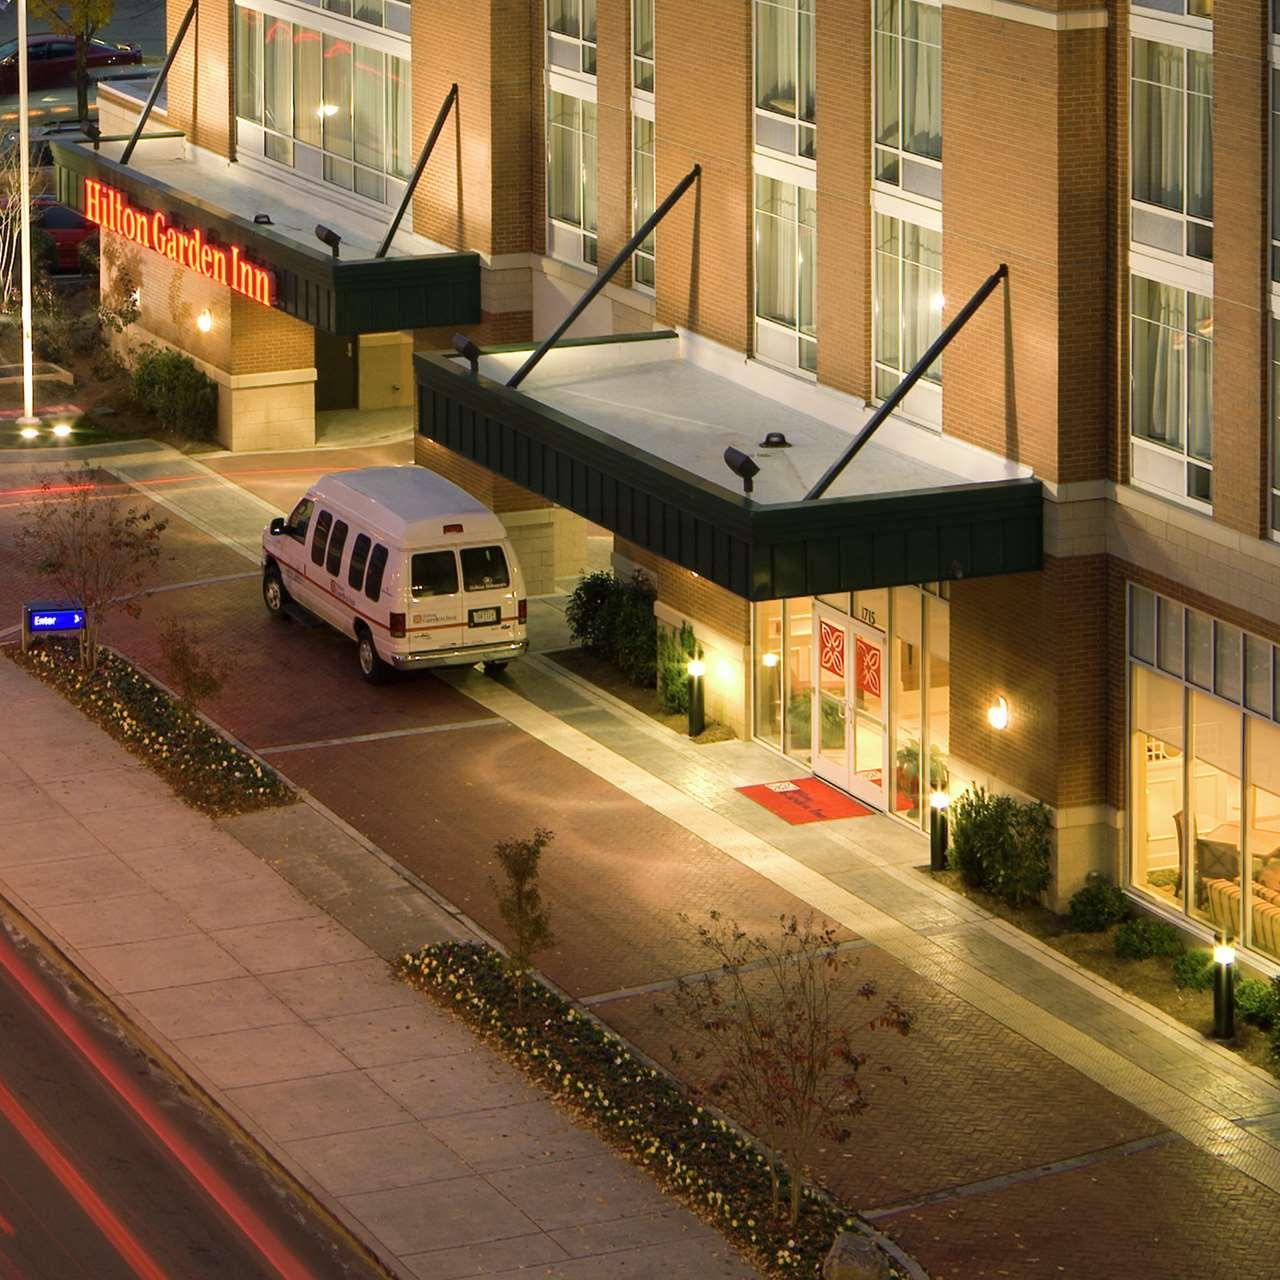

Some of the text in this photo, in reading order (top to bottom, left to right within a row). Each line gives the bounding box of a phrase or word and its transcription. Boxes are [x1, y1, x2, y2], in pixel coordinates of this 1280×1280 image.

[85, 177, 271, 307] Hilton Garden Inn
[34, 615, 56, 626] Enter
[861, 607, 876, 625] 1715
